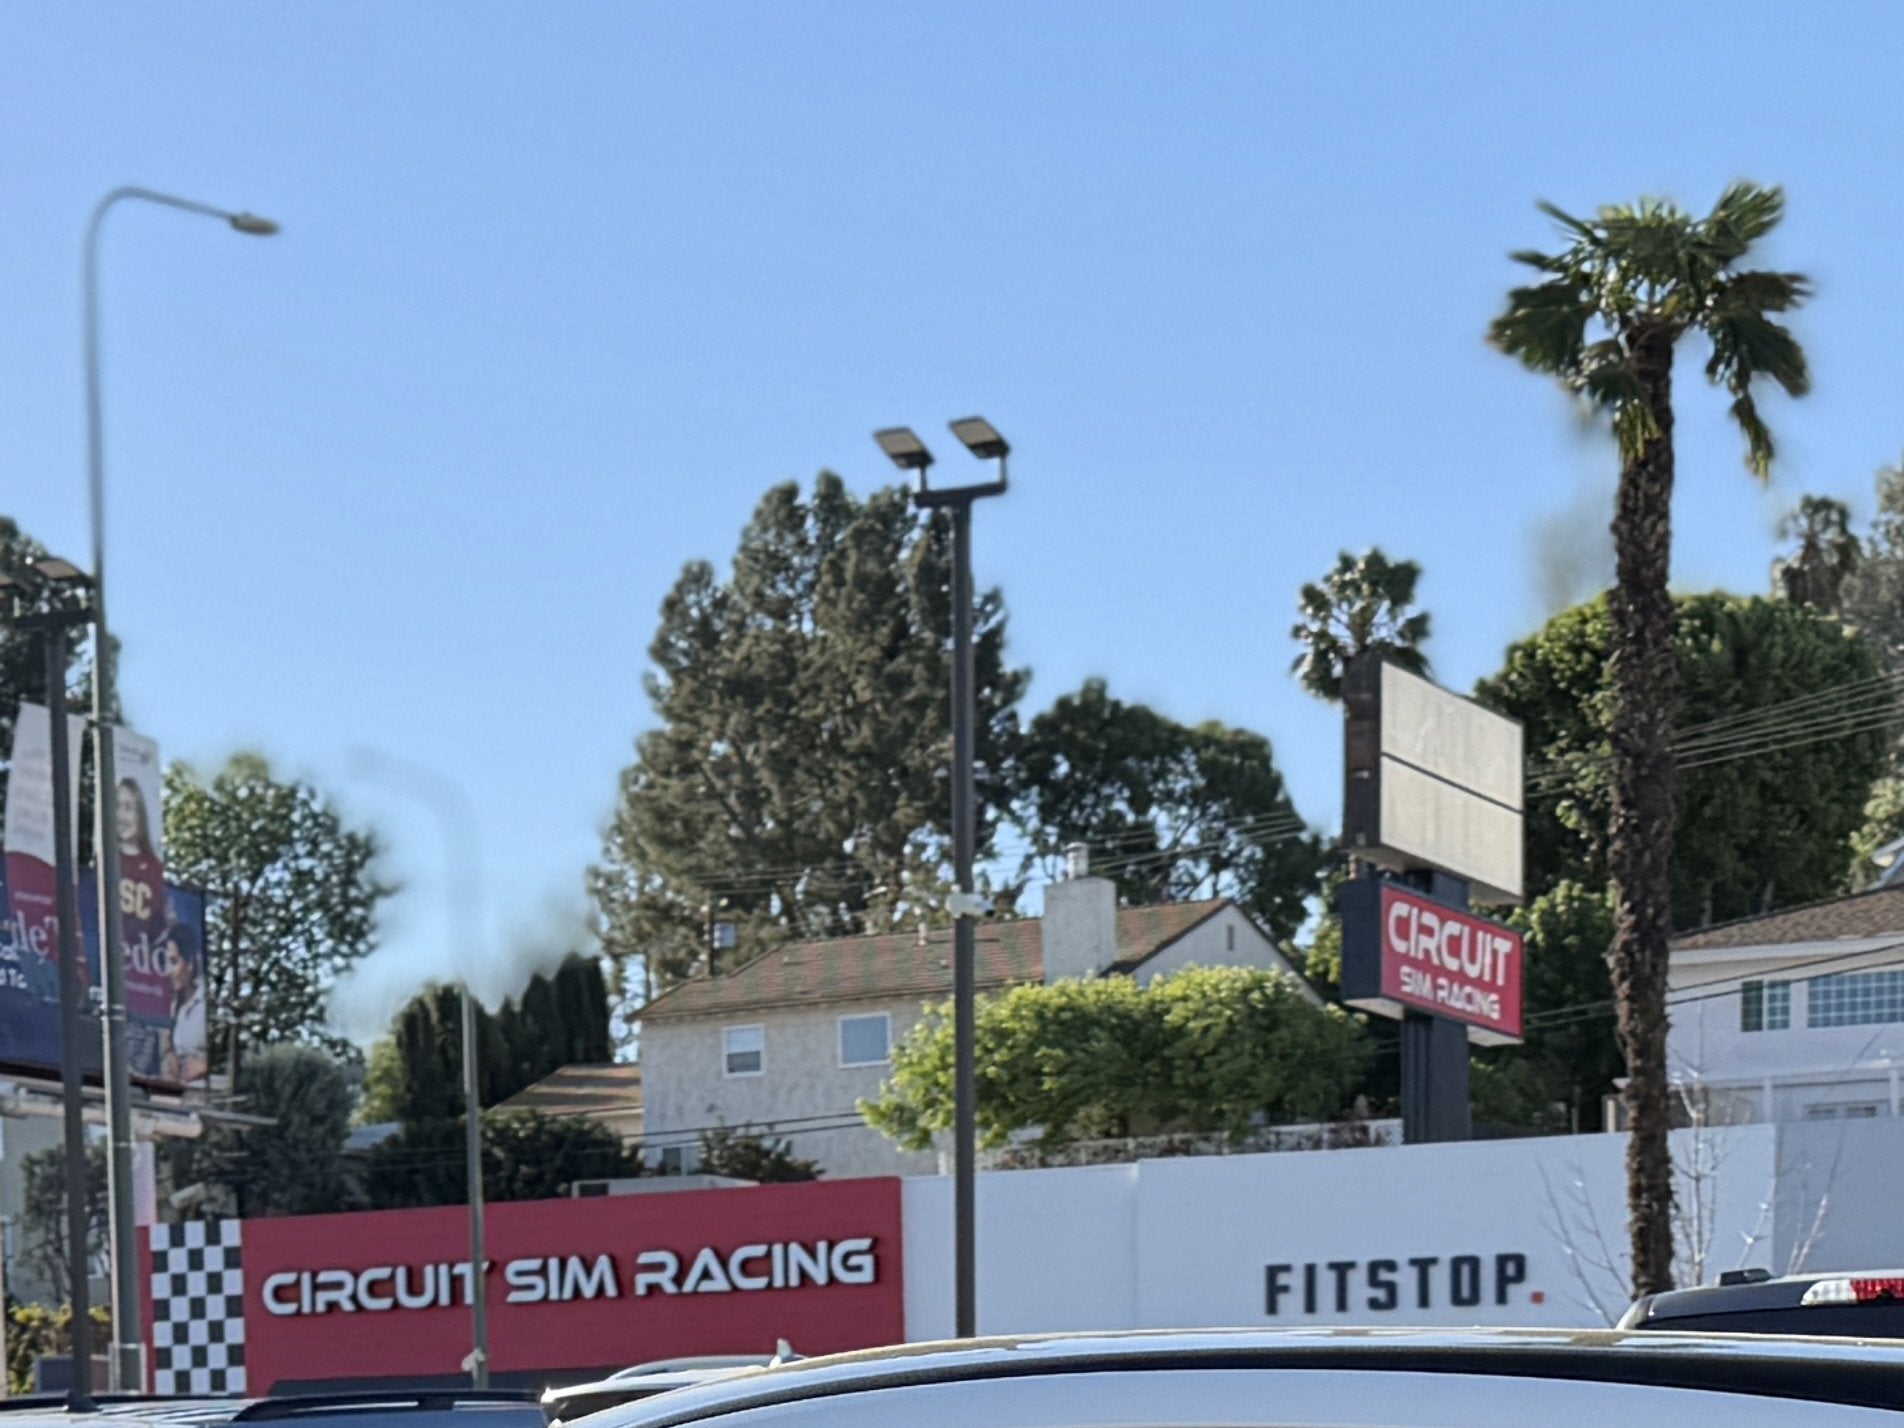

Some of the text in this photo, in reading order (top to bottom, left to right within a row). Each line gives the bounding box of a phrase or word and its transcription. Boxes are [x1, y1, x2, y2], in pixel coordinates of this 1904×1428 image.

[1388, 901, 1513, 986] CIRCUIT
[1400, 965, 1501, 1021] SIM RACING
[261, 1237, 875, 1317] CIRCUIT SIM RACING
[1265, 1253, 1545, 1316] FITSTOP.
